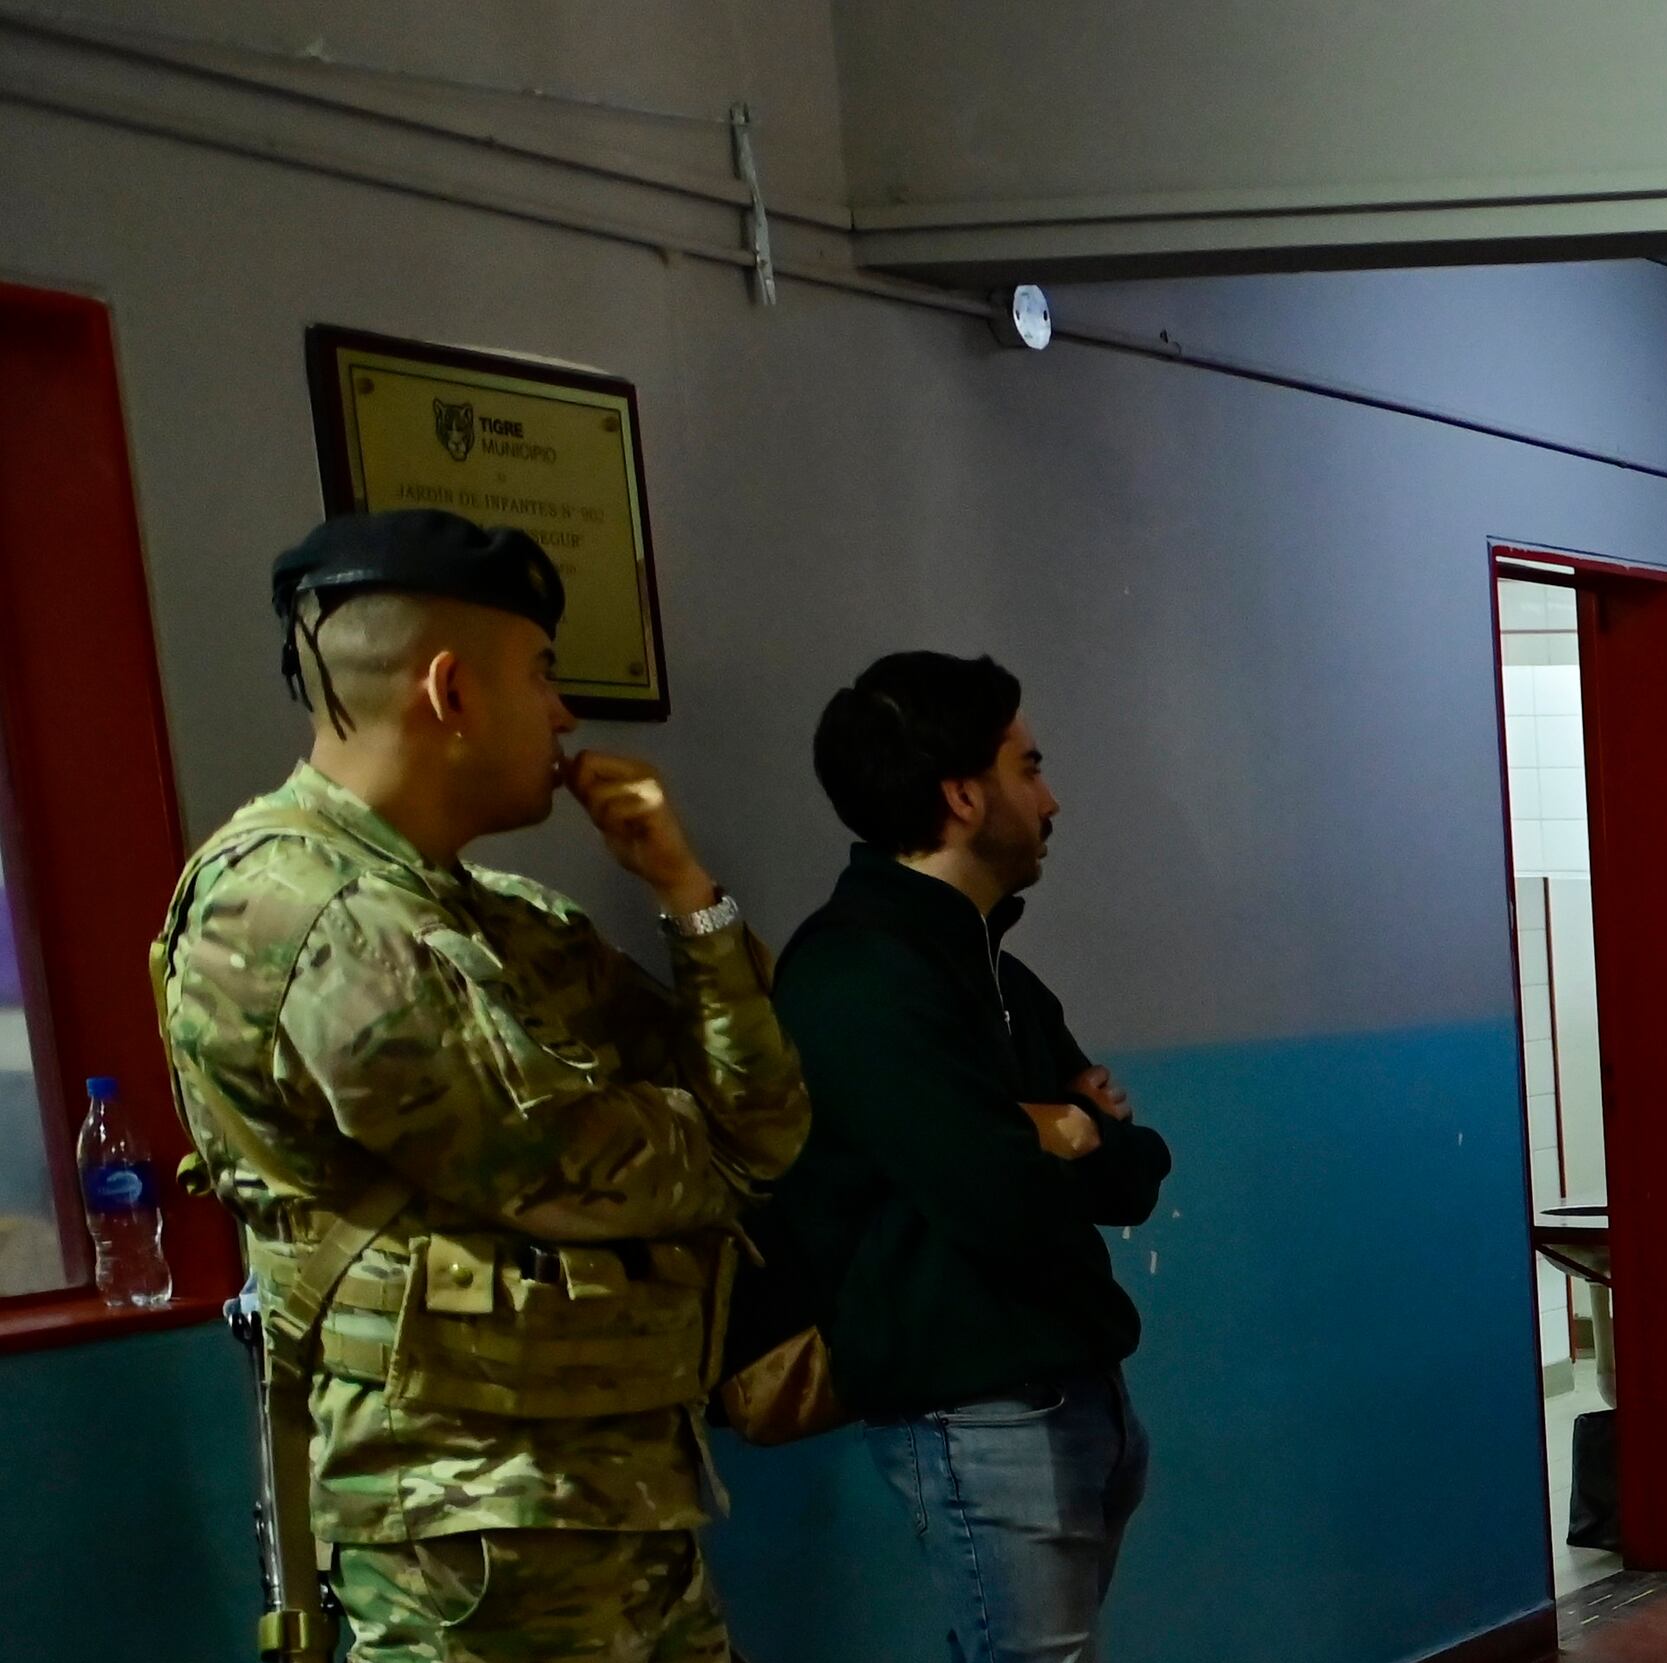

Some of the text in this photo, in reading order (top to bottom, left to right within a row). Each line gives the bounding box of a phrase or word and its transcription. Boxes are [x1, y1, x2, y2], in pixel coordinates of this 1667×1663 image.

[480, 418, 525, 438] TIGRE
[482, 439, 557, 464] MUNICIPIO
[459, 491, 480, 507] DE
[485, 494, 558, 518] INFANTES
